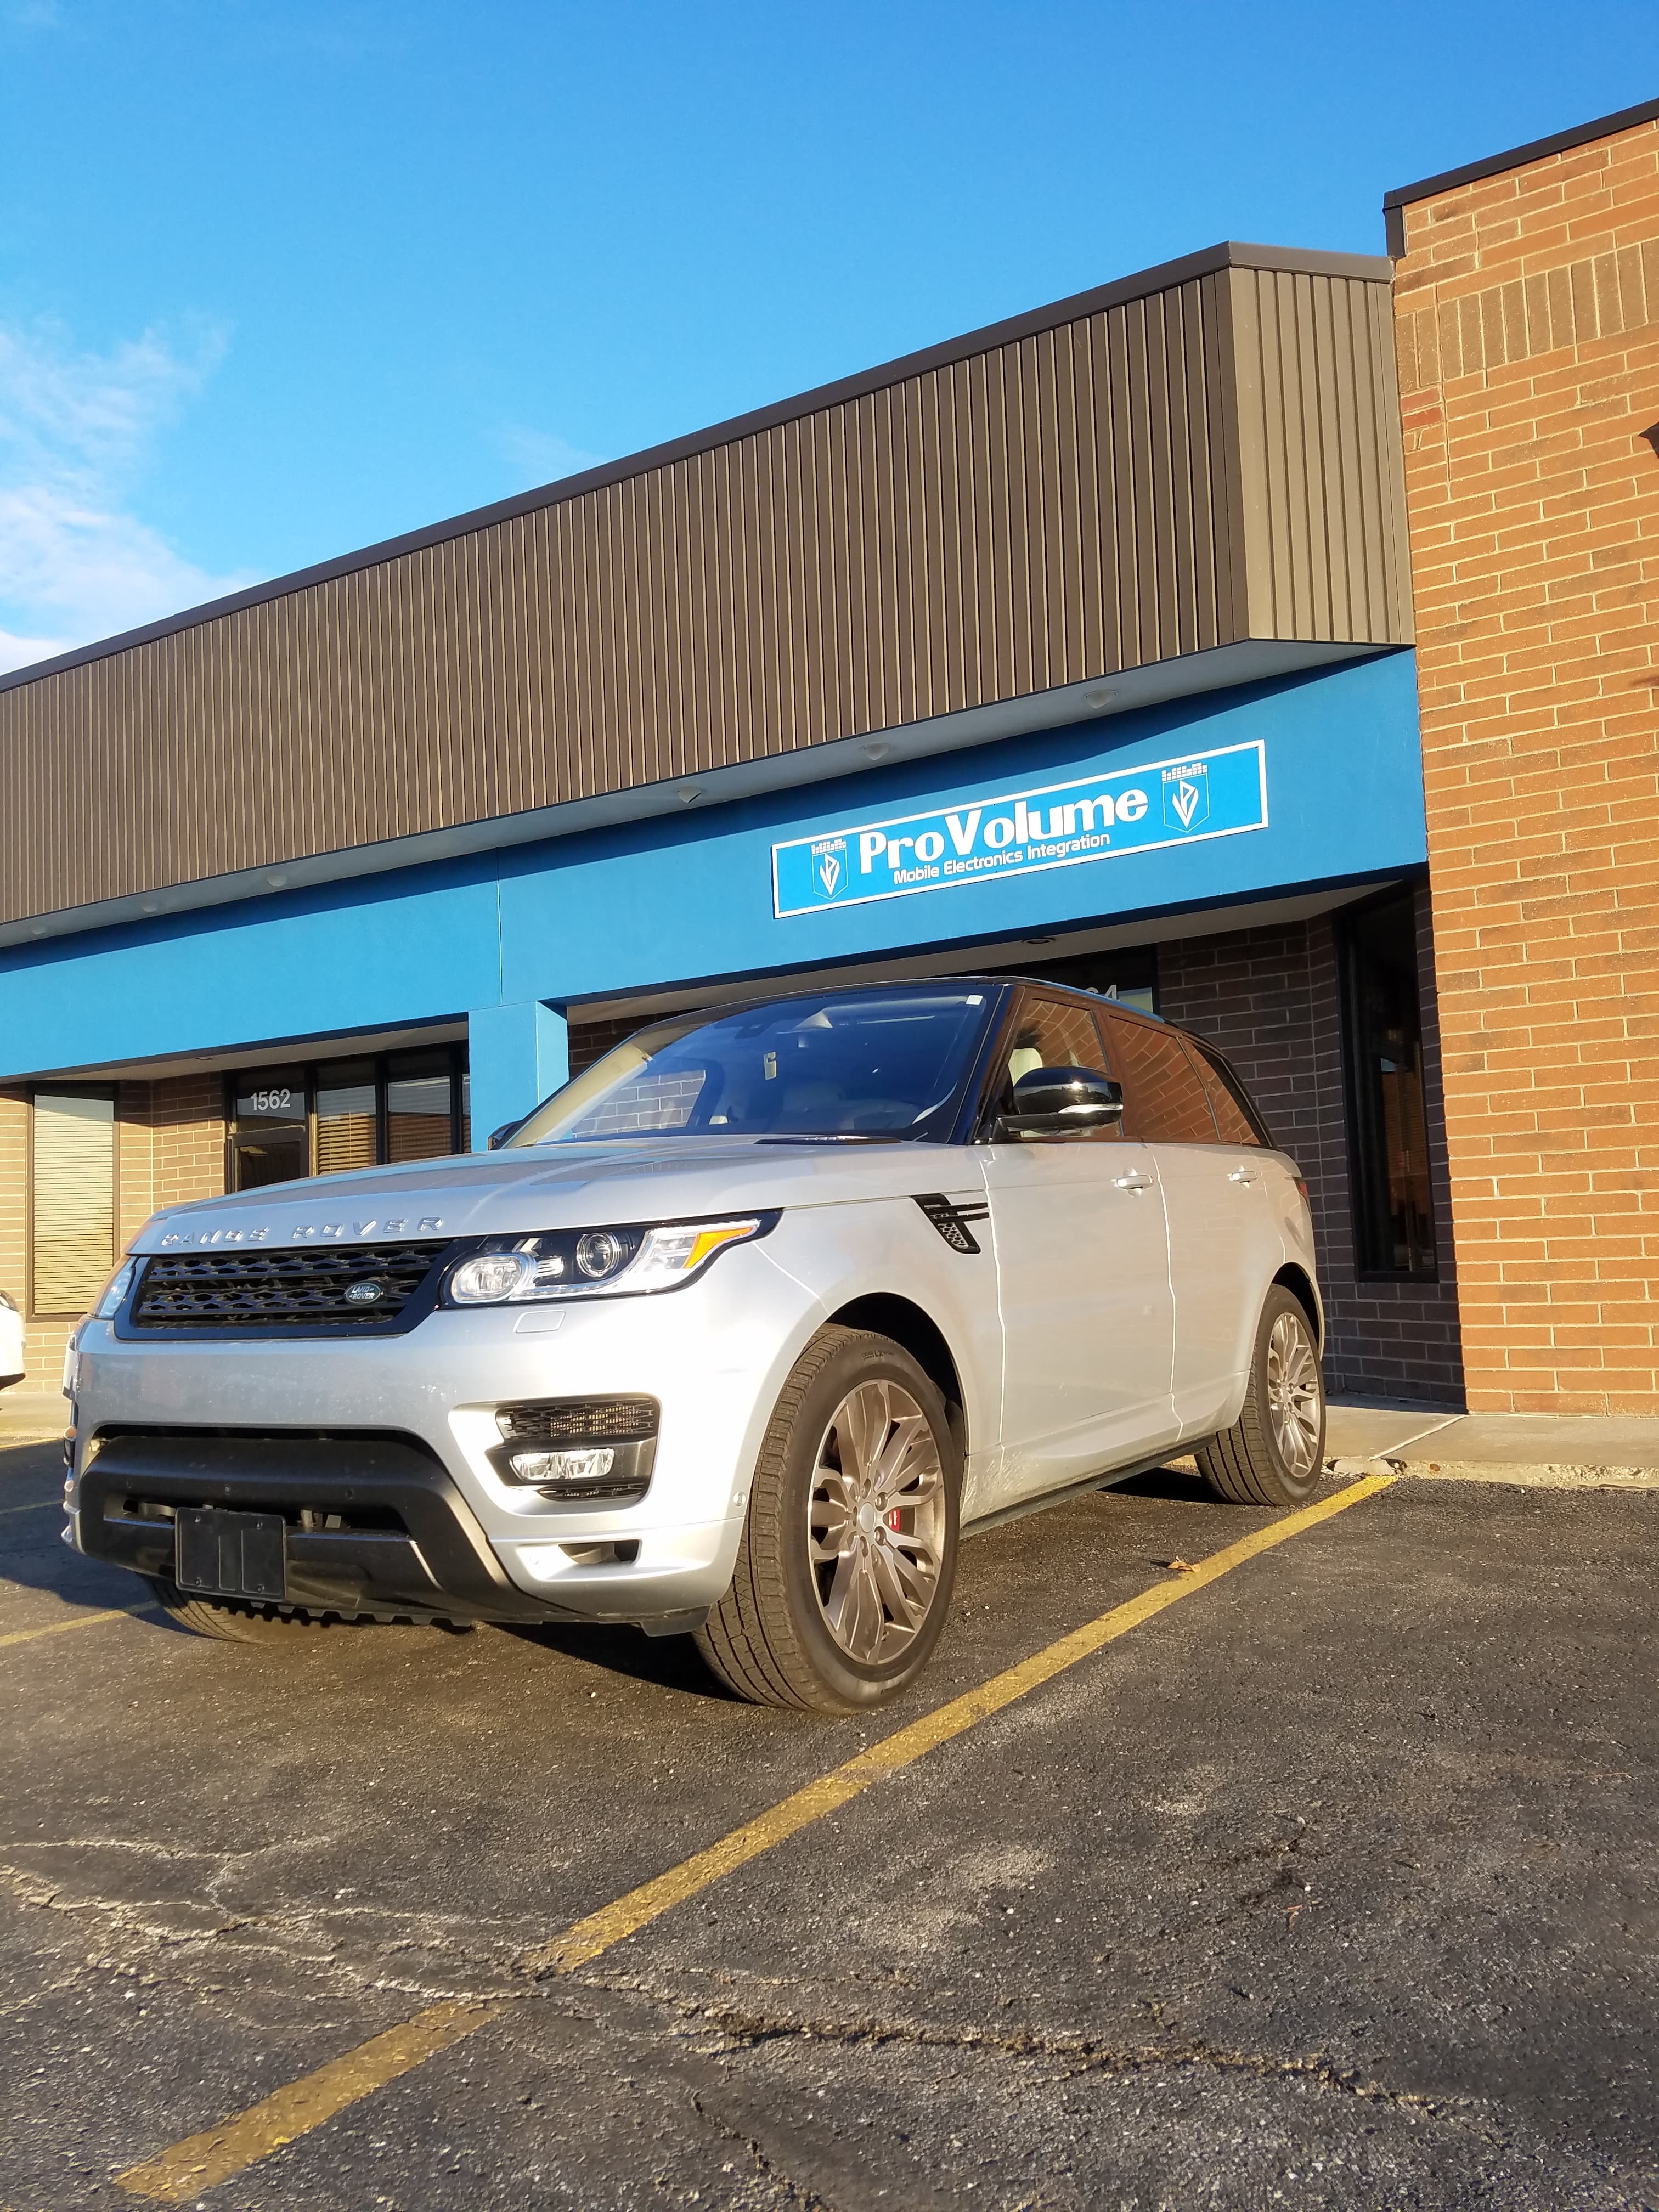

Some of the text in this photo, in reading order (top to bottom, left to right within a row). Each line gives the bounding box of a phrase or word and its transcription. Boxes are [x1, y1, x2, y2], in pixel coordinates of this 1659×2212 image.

[859, 789, 1149, 874] ProVolume
[894, 832, 1110, 885] Mobile Electronics Integration
[250, 1088, 291, 1111] 1562
[161, 1216, 444, 1247] RANGE ROVER
